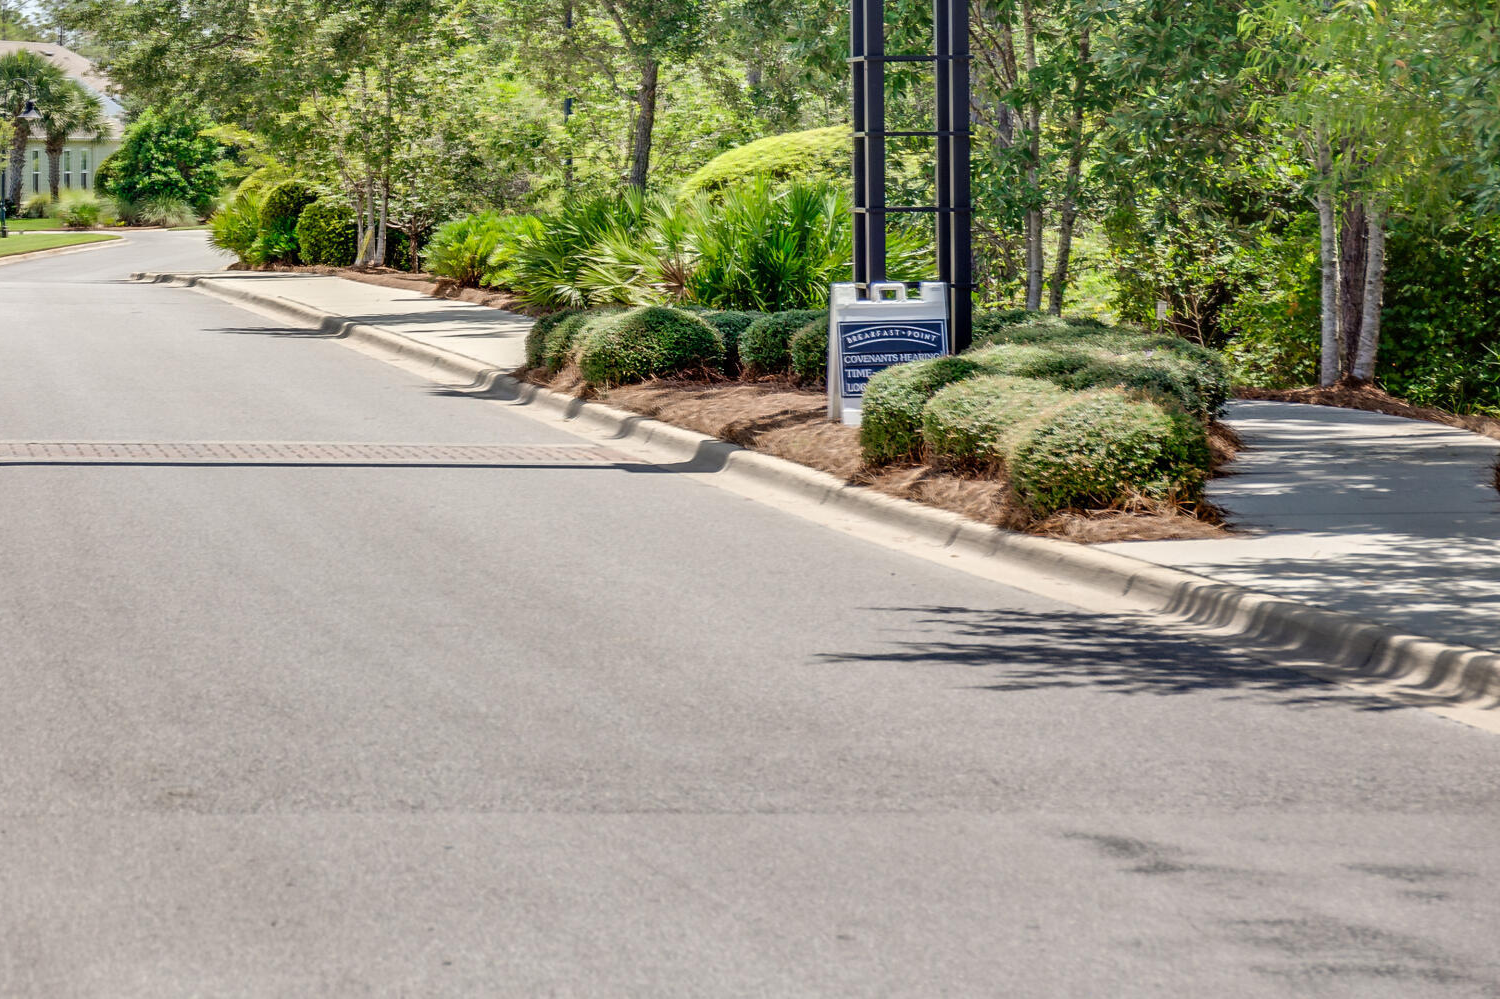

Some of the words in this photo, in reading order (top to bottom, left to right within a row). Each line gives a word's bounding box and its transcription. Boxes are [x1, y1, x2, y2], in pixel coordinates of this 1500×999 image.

[846, 329, 899, 344] BREAKFAST
[907, 330, 937, 341] POINT
[844, 354, 898, 364] COVENANTS
[900, 352, 940, 362] HEARING
